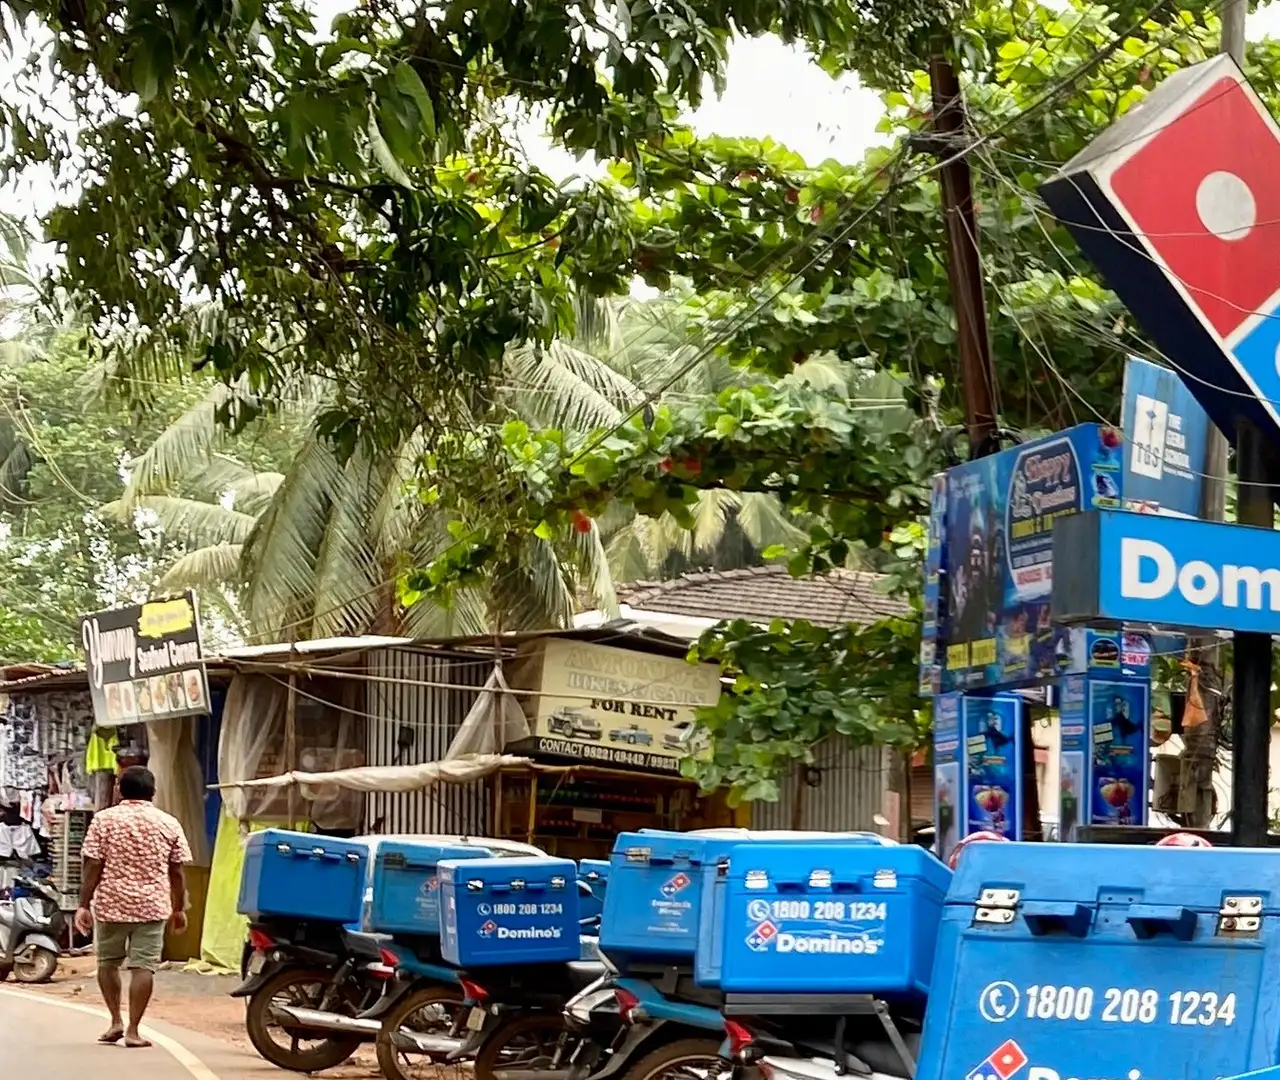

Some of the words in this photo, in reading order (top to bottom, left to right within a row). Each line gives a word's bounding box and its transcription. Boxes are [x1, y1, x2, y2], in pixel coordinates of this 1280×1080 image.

[590, 698, 626, 715] FOR
[631, 702, 677, 722] RENT
[540, 738, 584, 756] CONTACT
[493, 904, 515, 915] 1800
[519, 904, 537, 915] 208
[540, 903, 563, 914] 1234
[771, 901, 809, 918] 1800
[813, 901, 844, 919] 208
[849, 902, 887, 920] 1234
[498, 926, 561, 939] Domino's
[776, 933, 880, 955] Domino's
[1025, 984, 1093, 1020] 1800
[1101, 989, 1158, 1023] 208
[1169, 991, 1236, 1027] 1234
